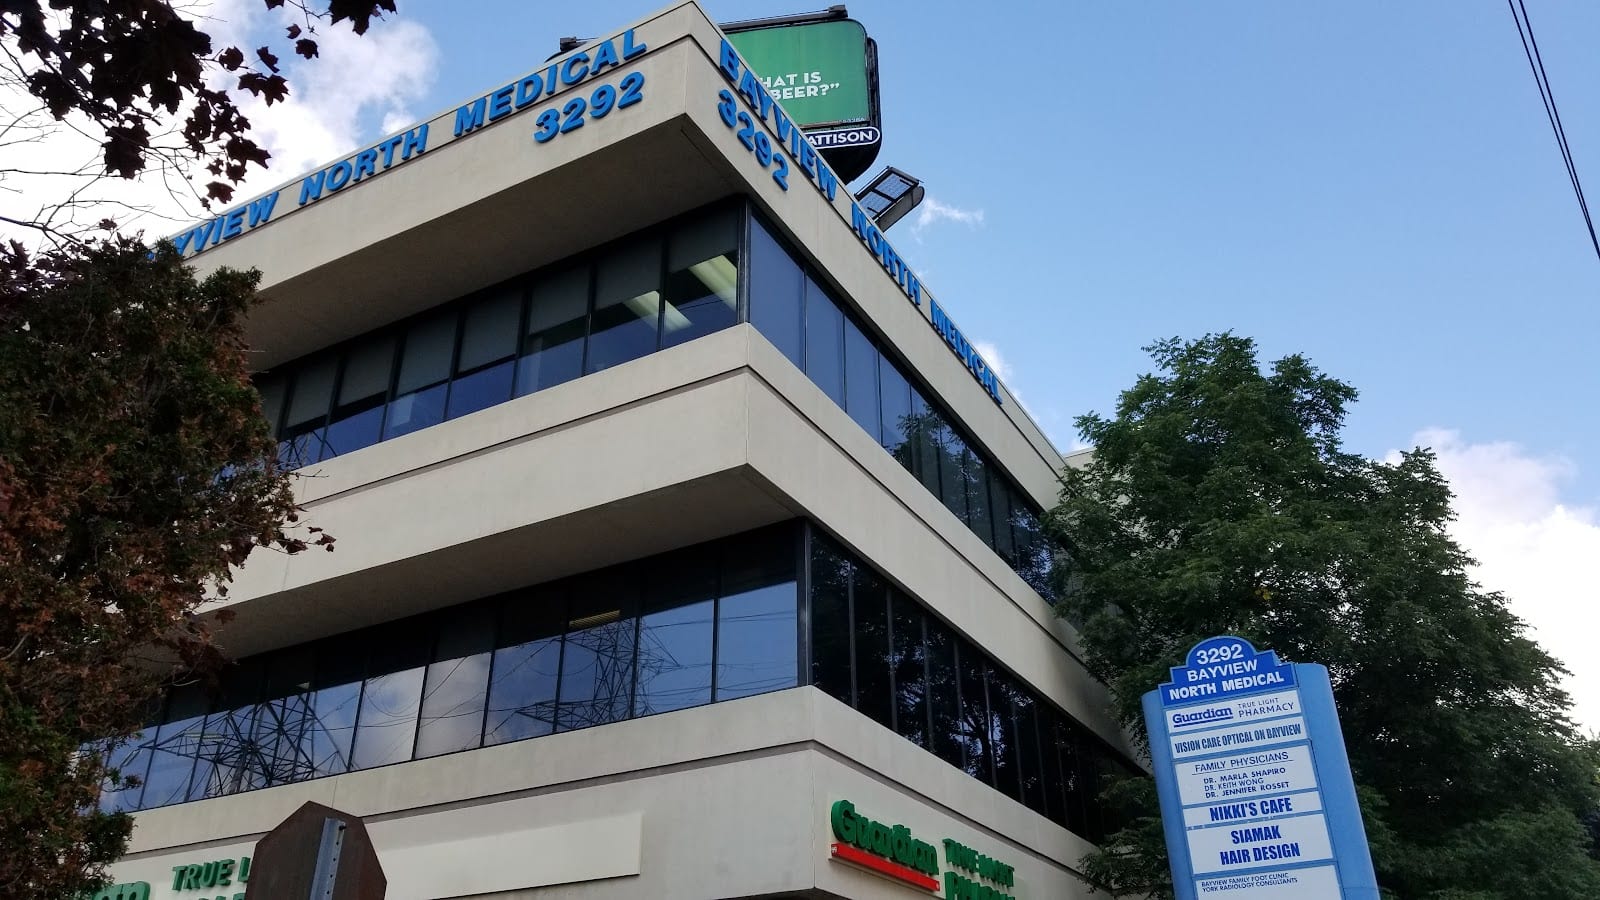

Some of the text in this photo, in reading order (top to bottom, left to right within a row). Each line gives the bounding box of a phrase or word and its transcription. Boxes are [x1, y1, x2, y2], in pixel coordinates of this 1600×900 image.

[759, 71, 822, 88] HAT IS
[298, 123, 429, 205] NORTH
[453, 28, 648, 137] MEDICAL
[533, 71, 645, 143] 3292
[718, 89, 789, 191] 3292
[808, 130, 873, 146] ATTISON
[719, 38, 1003, 405] BAYVIEW NORTH MEDICAL
[1196, 643, 1244, 665] 3292
[1186, 659, 1258, 682] BAYVIEW
[1169, 671, 1284, 700] NORTH MEDICAL
[1237, 697, 1279, 709] TRUE LIGHT
[1238, 702, 1294, 718] PHARMACY
[1172, 707, 1233, 724] Guardian
[1174, 723, 1302, 754] VISION CARE OPTICAL ON BAYVIEW
[1195, 751, 1289, 773] FAMILY PHYSICIANS
[1203, 767, 1286, 785] DR. MARLA SHAPIRO
[1218, 781, 1237, 791] KEITH
[1239, 777, 1264, 787] WONG
[1221, 786, 1257, 797] JENNIFER
[1260, 781, 1290, 792] ROSSET
[1209, 797, 1293, 822] NIKKI'S CAFE
[831, 800, 939, 875] Guardian
[1230, 825, 1282, 845] SIAMAK
[1220, 842, 1301, 866] HAIR DESIGN
[172, 859, 235, 891] TRUE
[1201, 872, 1289, 888] BAYVIEW FAMILY FOOT CLINIC
[1202, 877, 1298, 893] YORK RADIOLOGY CONSULTANTS
